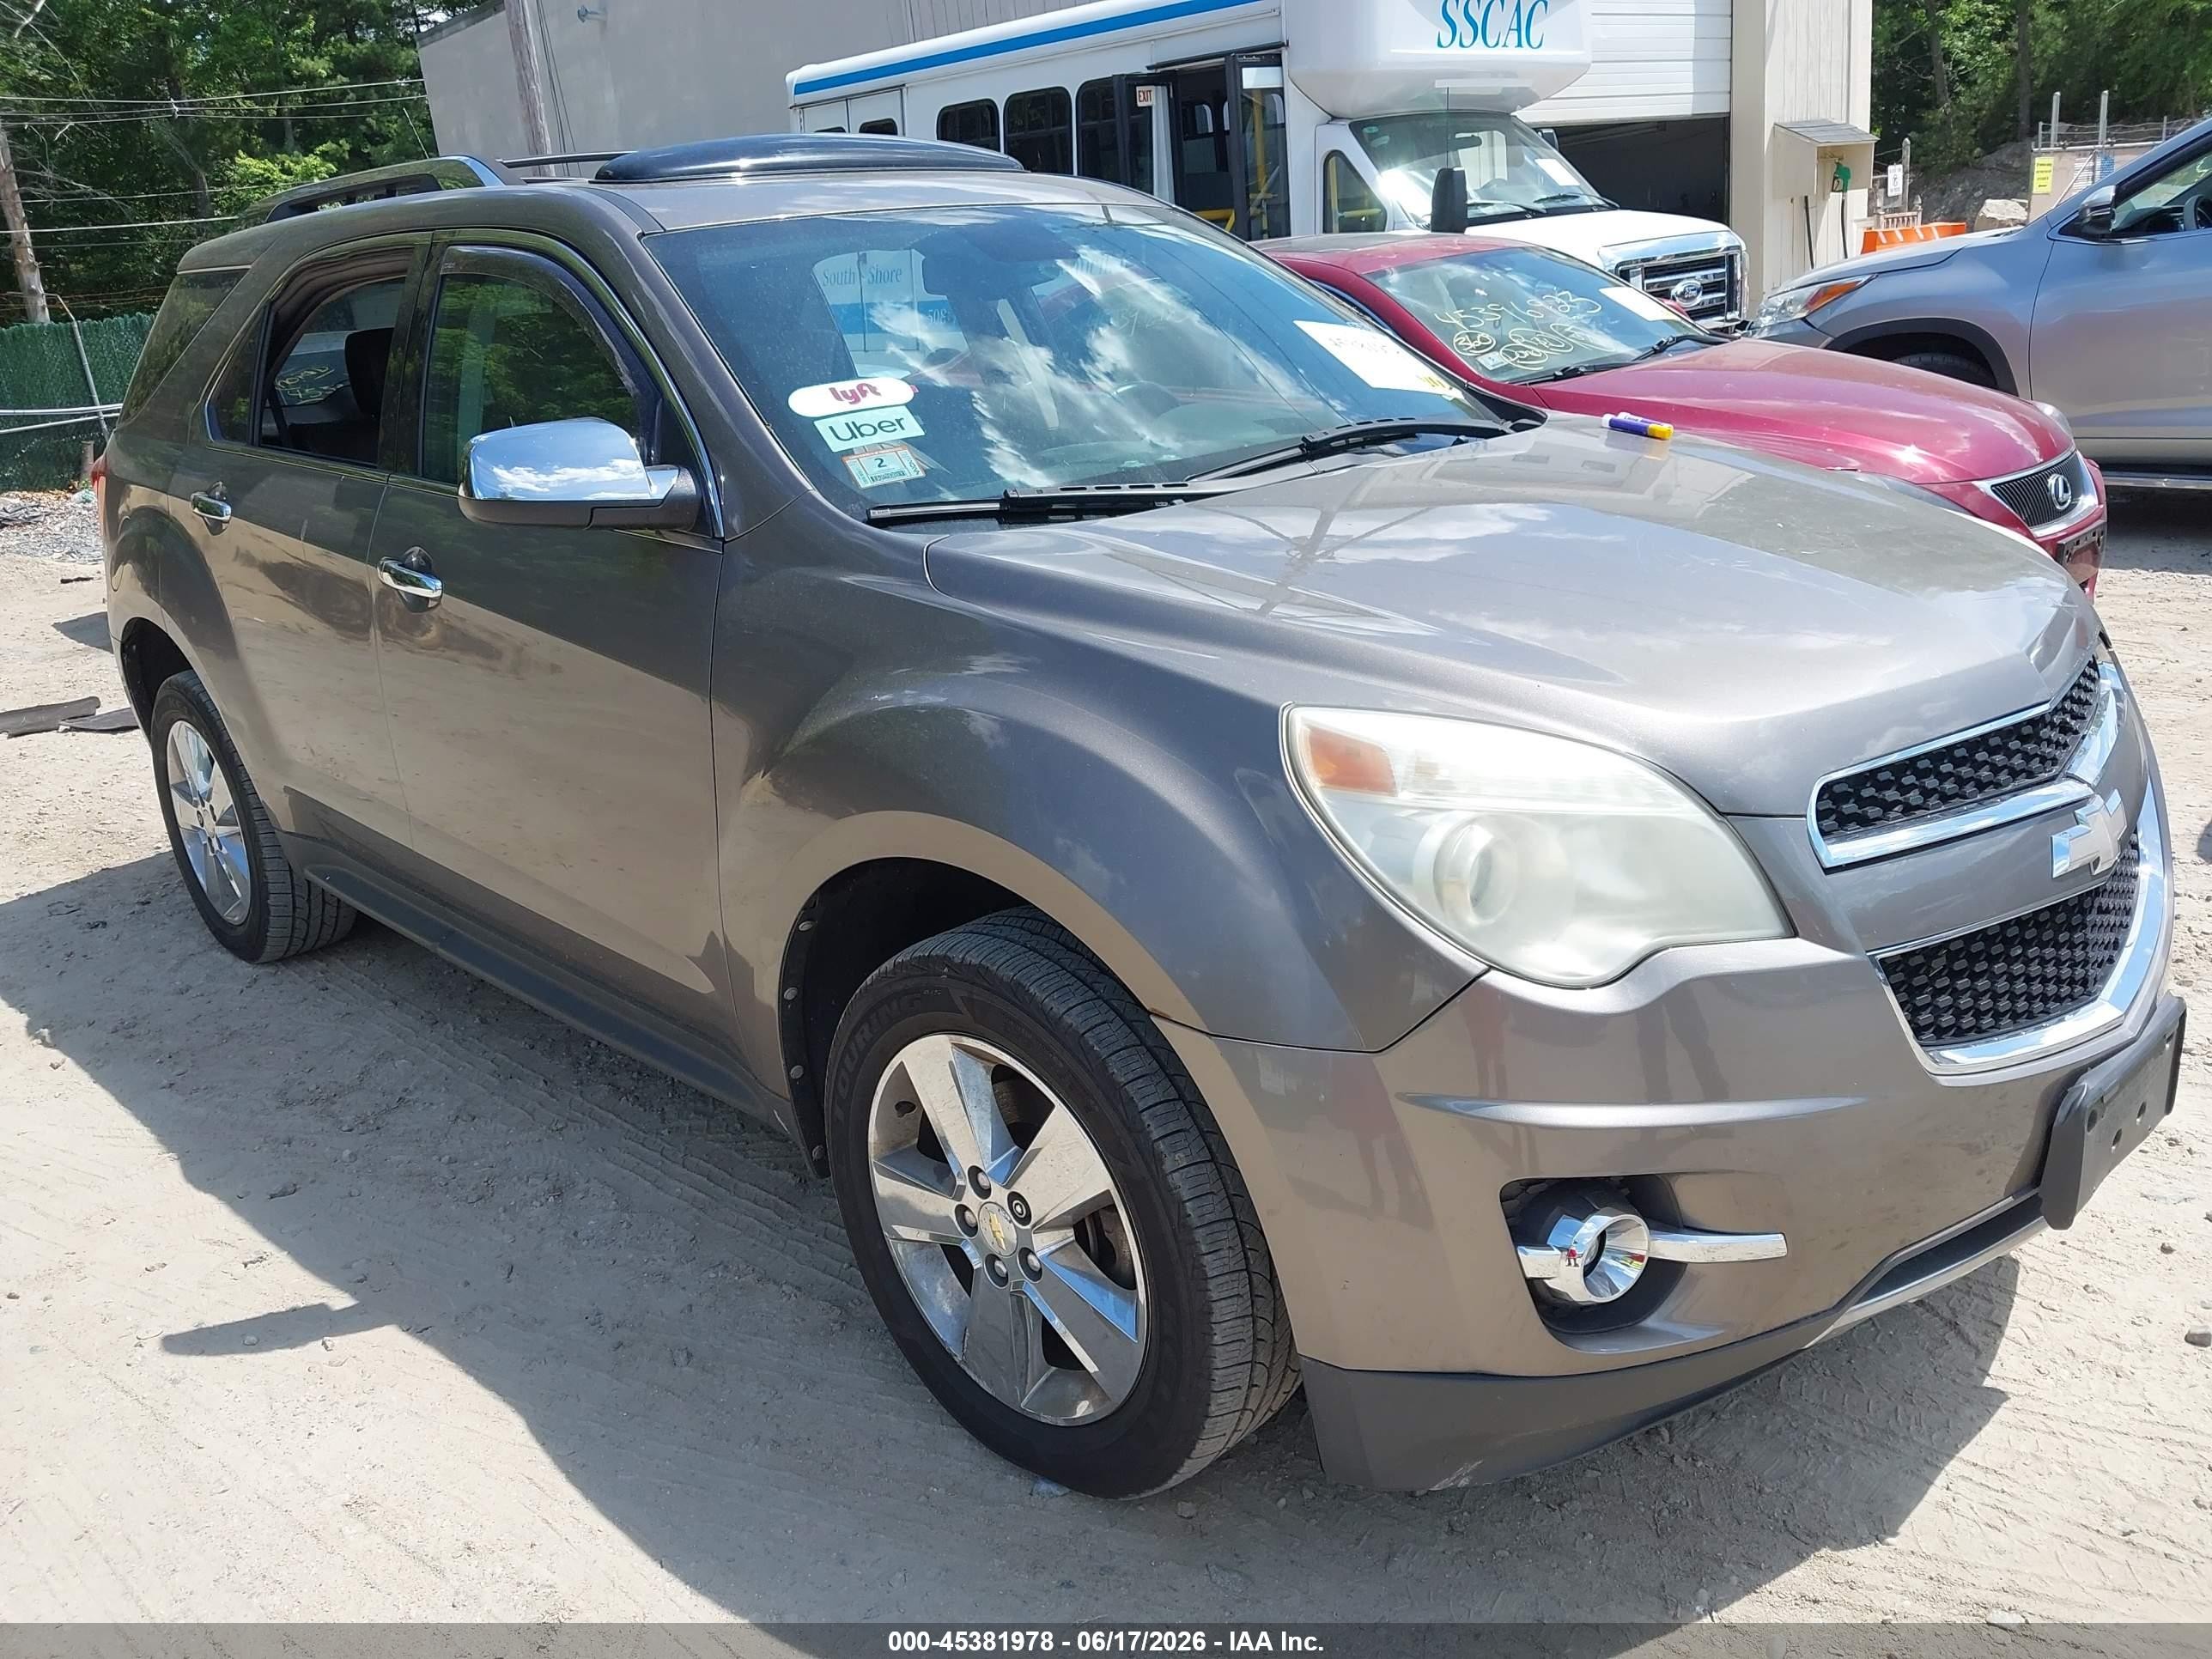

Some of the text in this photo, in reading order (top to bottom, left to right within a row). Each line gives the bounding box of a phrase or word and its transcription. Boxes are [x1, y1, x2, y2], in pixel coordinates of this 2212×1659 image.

[1437, 0, 1548, 50] SSCAC
[1138, 89, 1152, 102] EXIT
[823, 264, 902, 287] South Shore
[829, 383, 881, 405] lyft
[829, 417, 906, 441] Uber
[874, 458, 887, 468] 2
